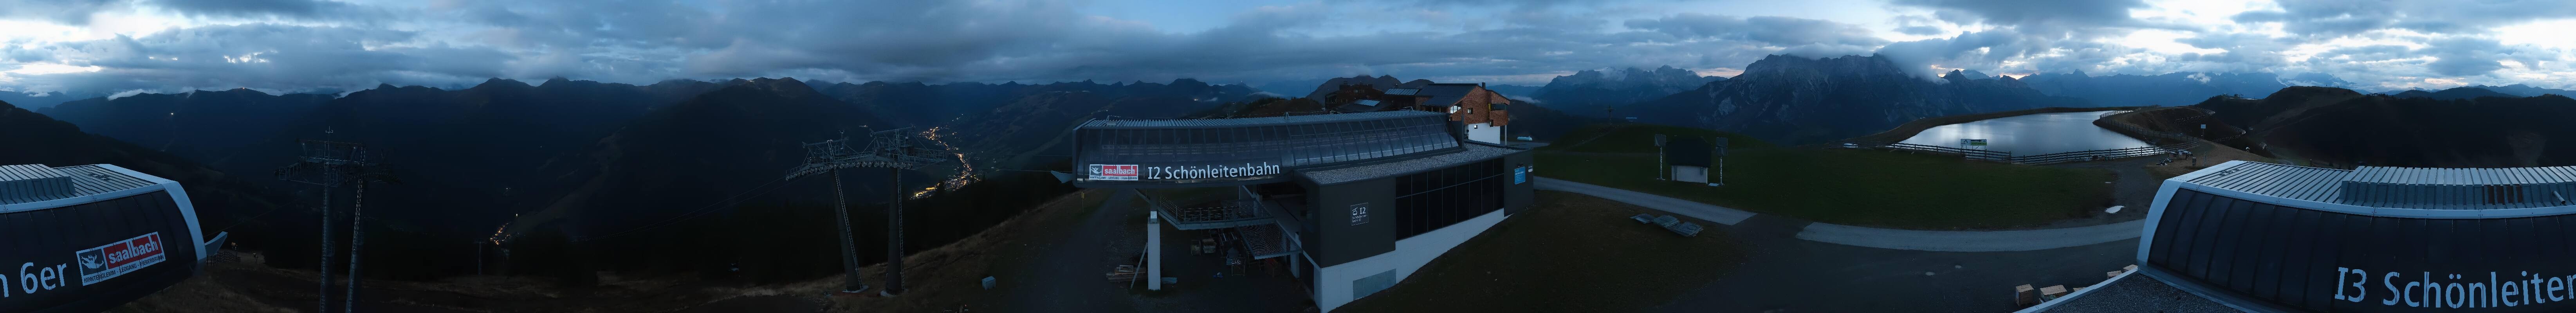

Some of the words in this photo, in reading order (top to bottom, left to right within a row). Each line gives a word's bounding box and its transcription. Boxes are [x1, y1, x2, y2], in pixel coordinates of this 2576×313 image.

[1104, 165, 1135, 174] saalbach
[1148, 166, 1160, 179] I2
[1165, 162, 1280, 179] Schönleitenbahn
[108, 234, 159, 264] saalbach
[20, 262, 67, 294] 6er
[119, 264, 137, 273] LEOGANG
[2334, 267, 2367, 302] I3
